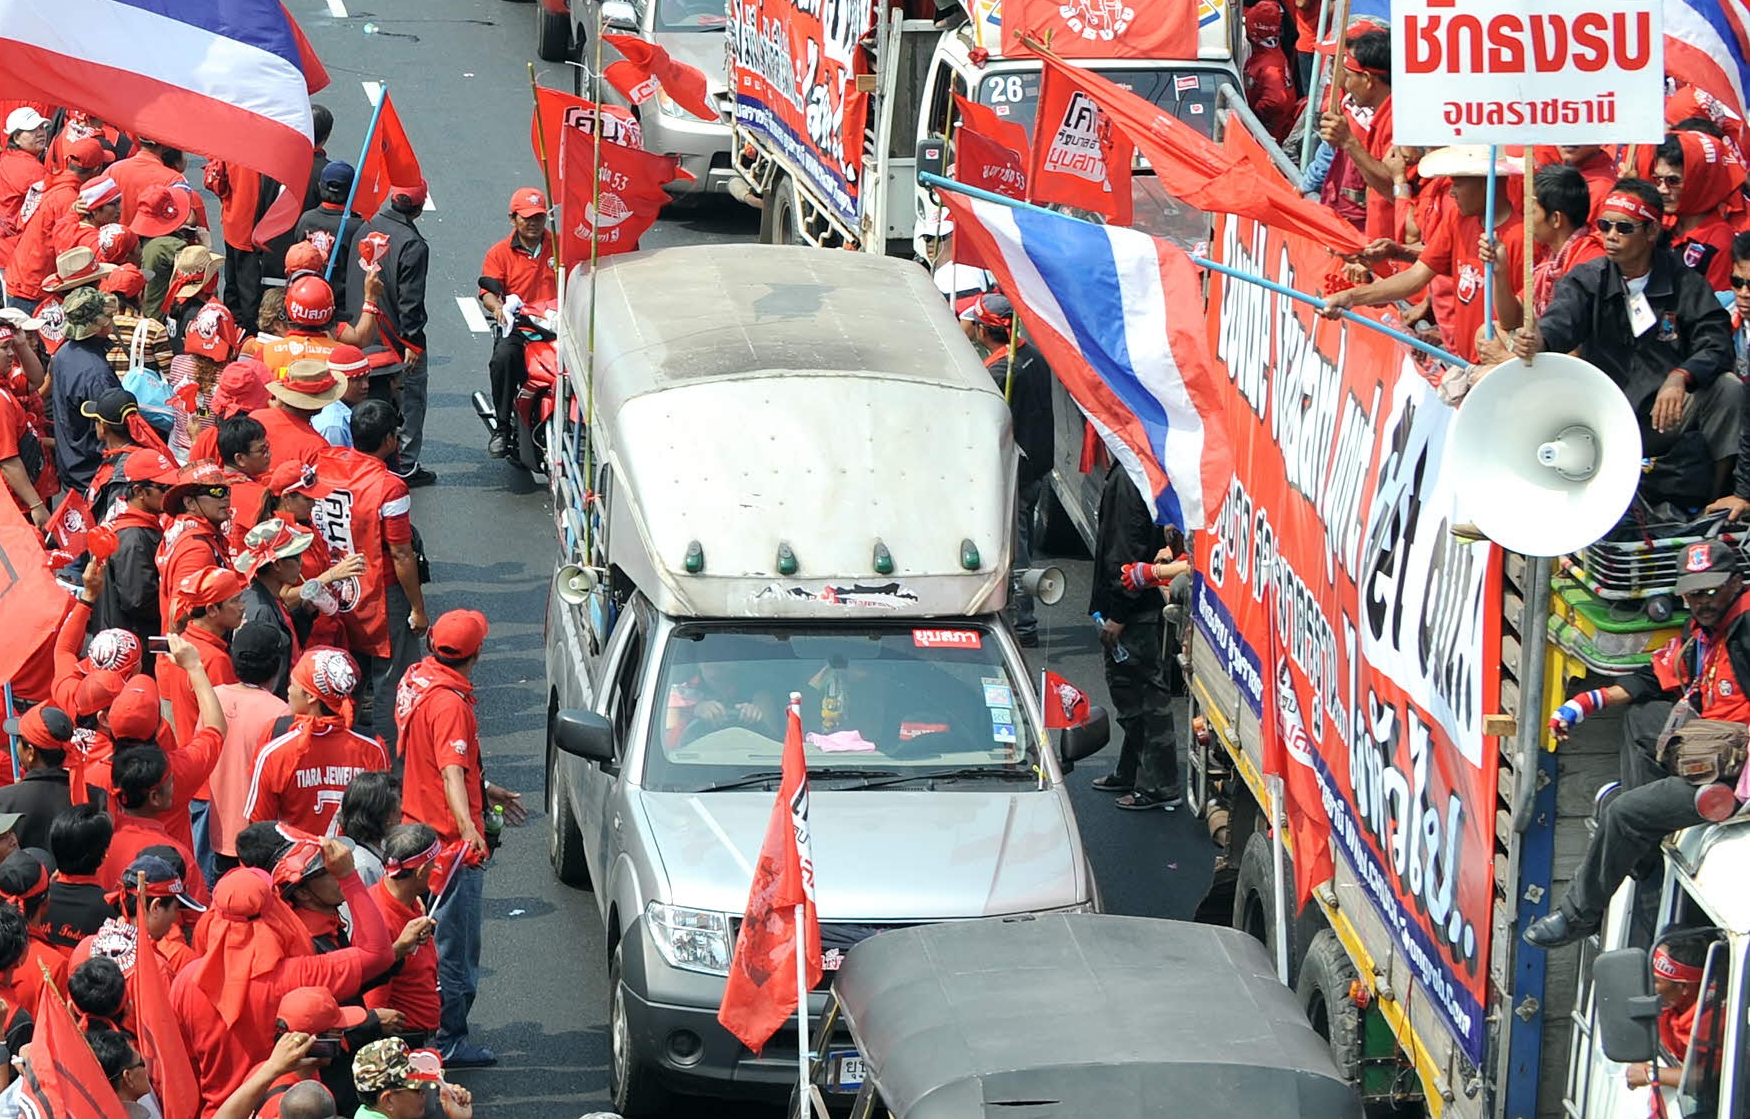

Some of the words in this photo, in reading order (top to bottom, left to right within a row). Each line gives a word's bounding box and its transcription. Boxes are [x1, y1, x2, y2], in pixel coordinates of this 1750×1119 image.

[988, 76, 1024, 103] 26
[1442, 90, 1616, 137] อุบลราชธานี
[915, 629, 978, 647] ยุบสภา
[296, 765, 323, 789] TIARA
